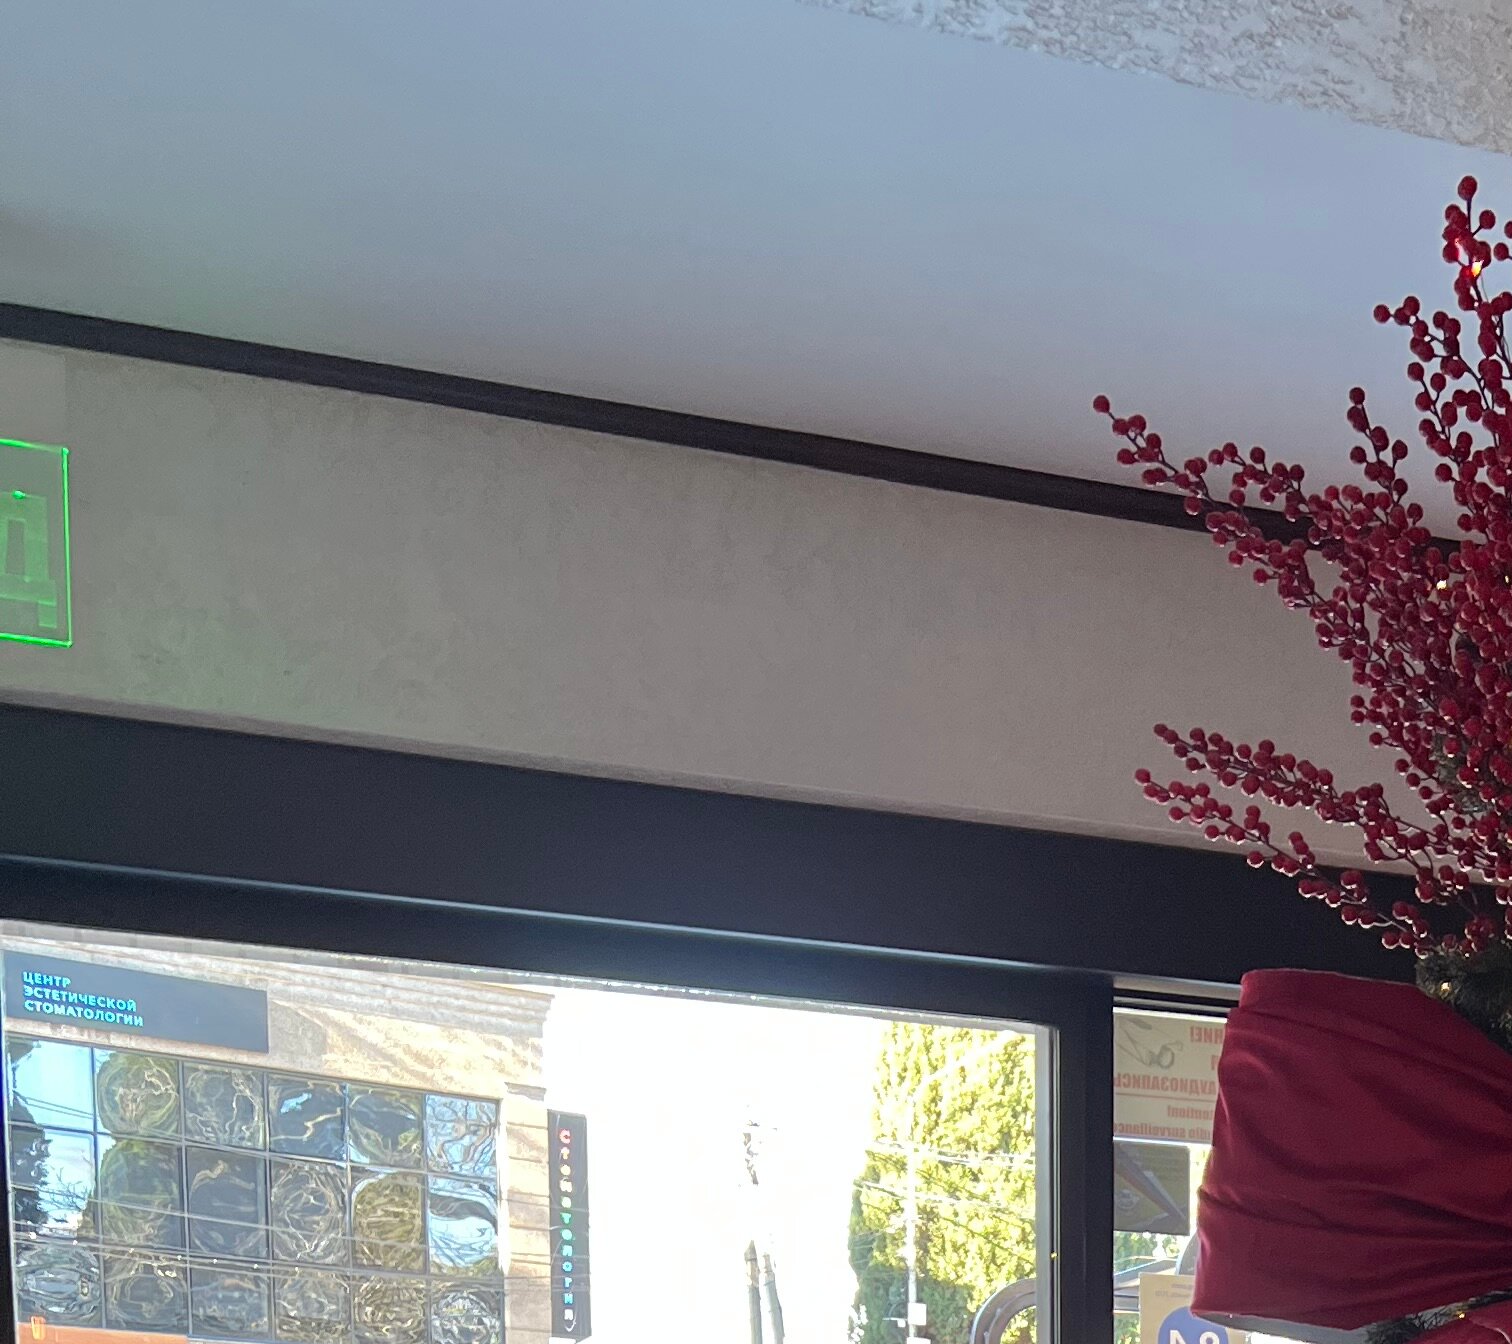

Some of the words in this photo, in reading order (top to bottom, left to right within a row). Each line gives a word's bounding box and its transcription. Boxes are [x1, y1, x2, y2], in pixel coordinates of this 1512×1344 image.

[23, 971, 72, 988] ЦЕНТР
[23, 984, 137, 1012] ЭСТЕТИЧЕСКОЙ
[24, 999, 144, 1027] СТОМАТОЛОГИИ
